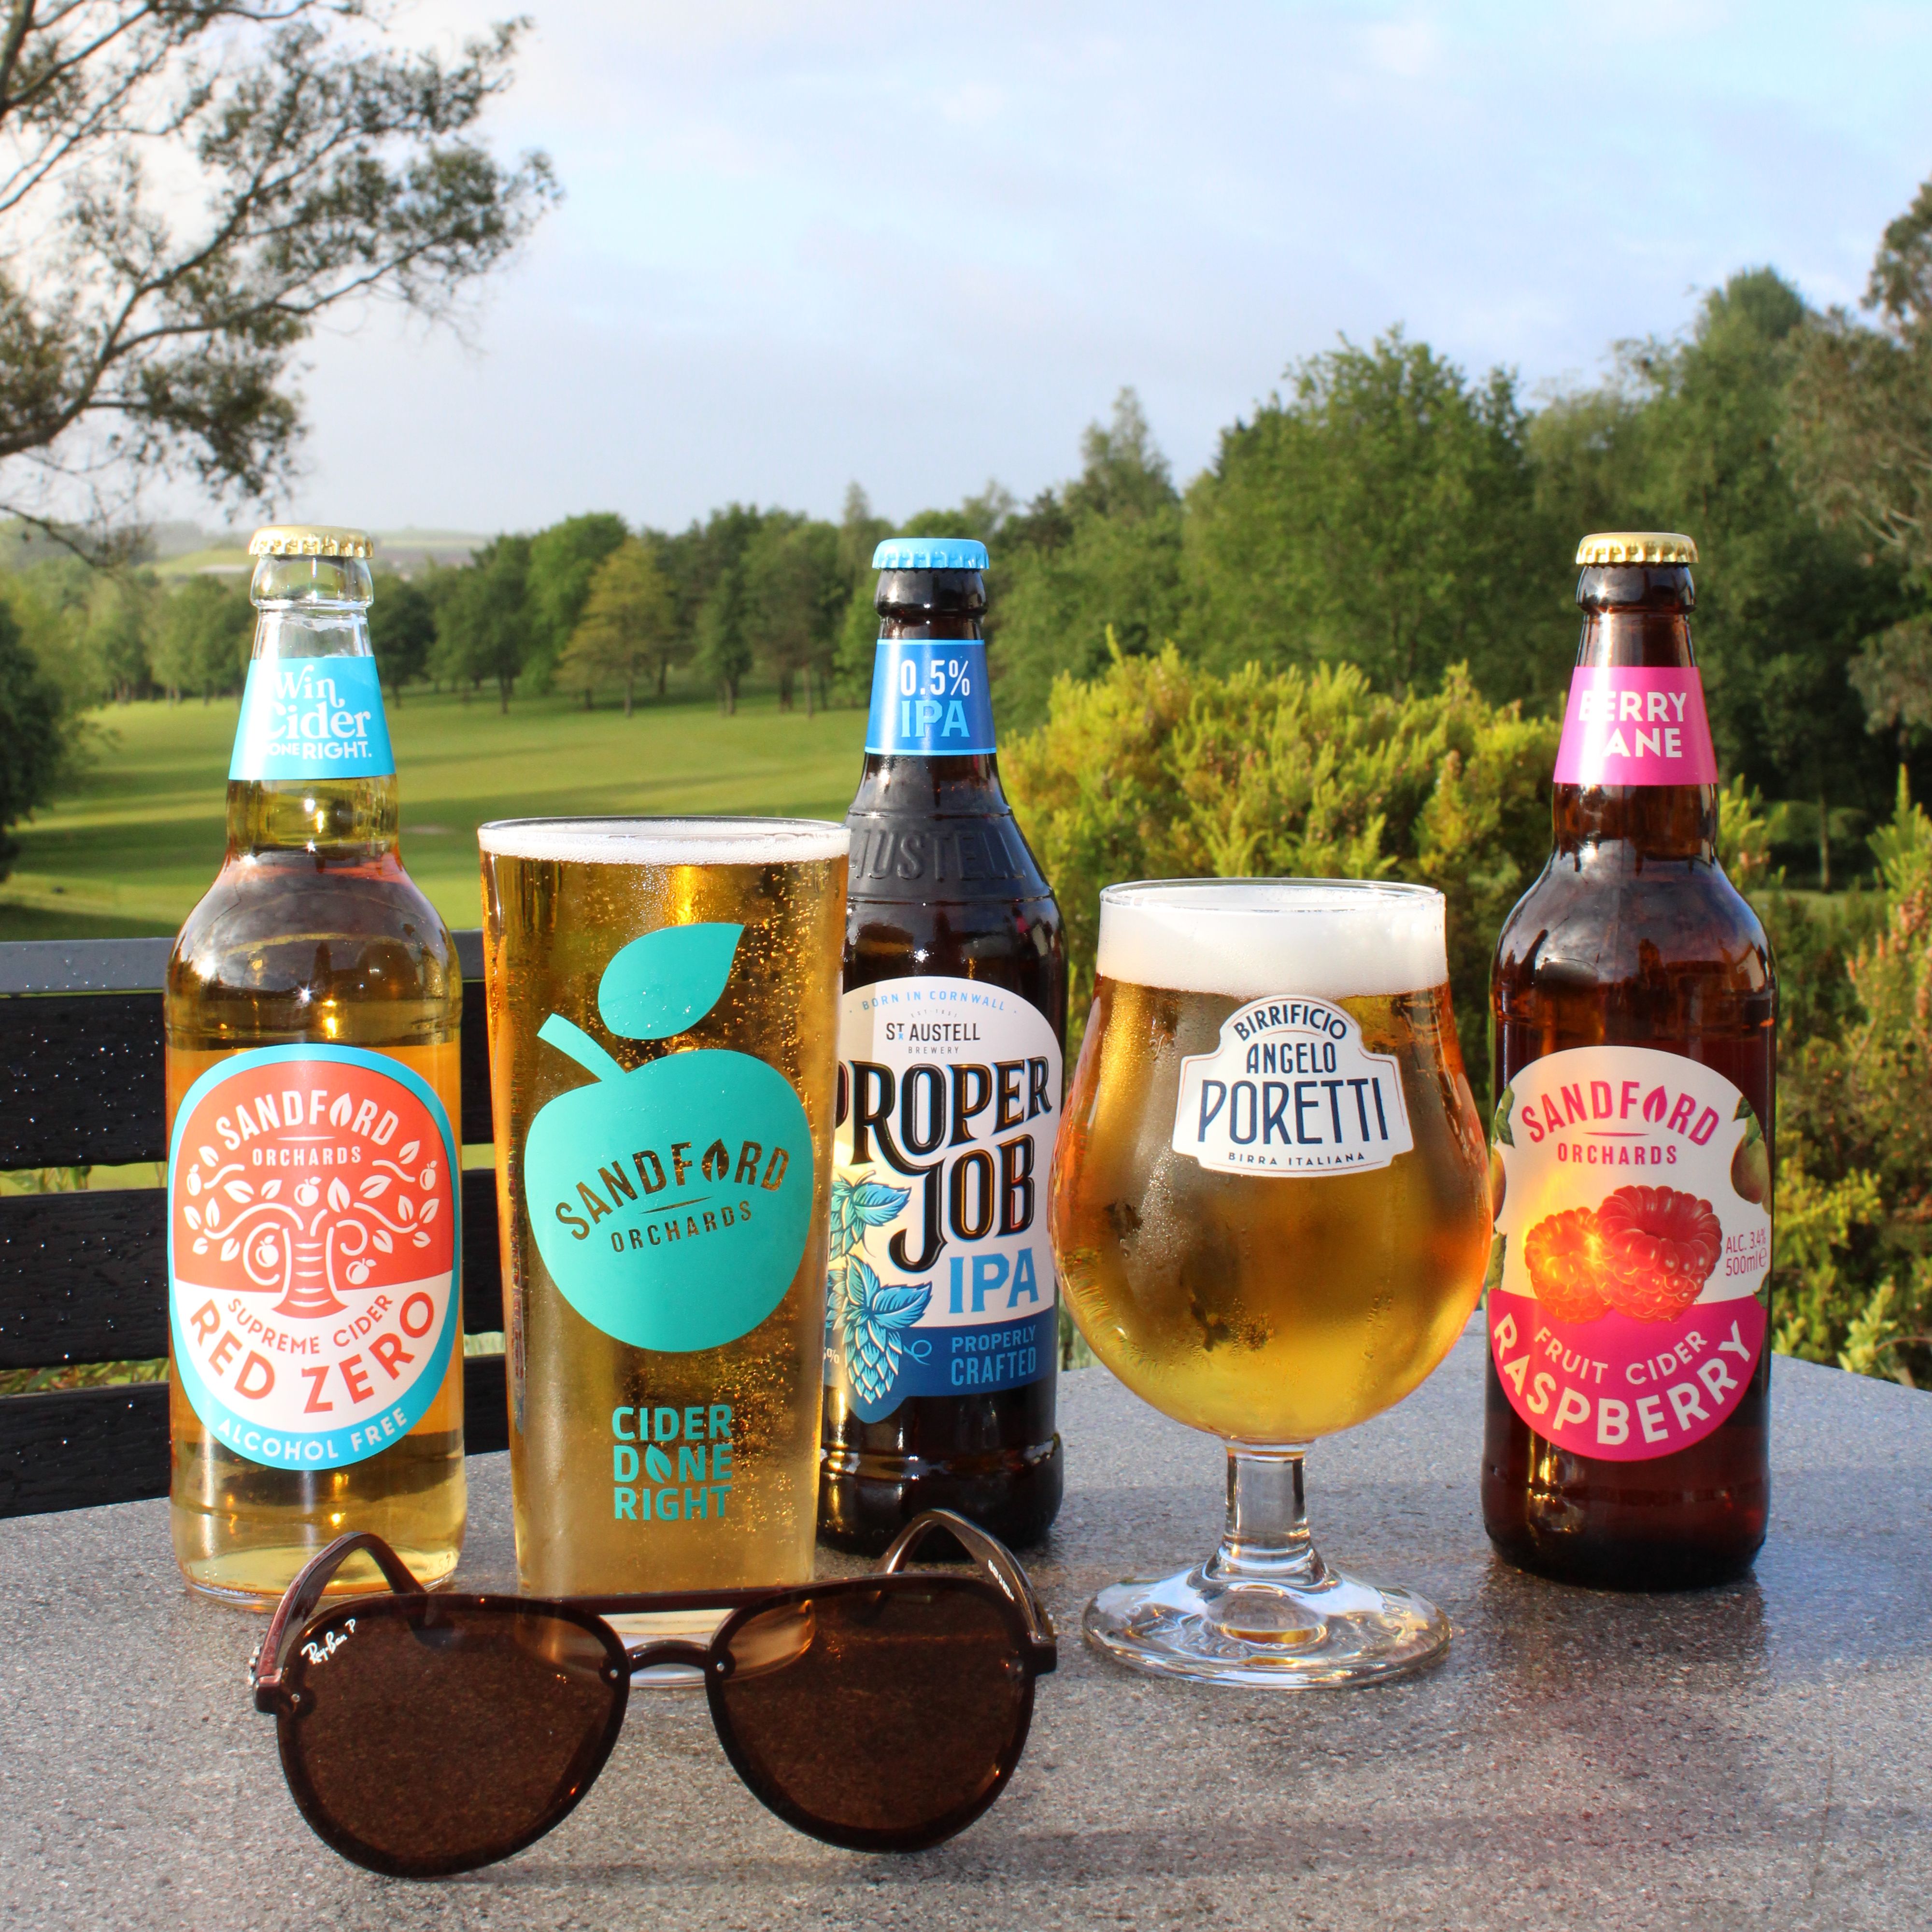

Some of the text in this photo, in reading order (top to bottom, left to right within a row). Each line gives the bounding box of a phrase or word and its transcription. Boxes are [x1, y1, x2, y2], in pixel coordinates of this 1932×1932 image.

[271, 665, 345, 708] Win
[900, 660, 970, 696] 0.5%
[265, 701, 371, 739] Cider
[901, 700, 970, 738] IPA
[261, 741, 372, 760] ONE RIGHT.
[1598, 728, 1682, 758] ANE
[862, 991, 1005, 1011] BORN IN CORNWALL
[909, 1023, 980, 1041] AUSTELL
[1234, 1004, 1347, 1041] BIRRIFICIO
[1246, 1042, 1336, 1074] ANGELO
[1197, 1077, 1388, 1145] PORETTI
[252, 1146, 361, 1166] ORCHARDS
[1228, 1152, 1364, 1166] BIRRA ITALIANA
[1558, 1143, 1677, 1165] ORCHARDS
[888, 1134, 1035, 1273] JOB
[611, 1200, 752, 1252] ORCHARDS
[1726, 1234, 1747, 1254] ALC.
[949, 1247, 1038, 1314] IPA
[228, 1294, 393, 1354] SUPREME CIDER
[952, 1325, 1036, 1353] PROPERLY
[190, 1292, 434, 1414] RED ZERO
[951, 1347, 1036, 1386] CRAFTED
[1534, 1326, 1707, 1385] FRUIT CIDER
[1494, 1313, 1750, 1445] RASPBERRY
[218, 1407, 407, 1461] ALCOHOL FREE
[612, 1404, 733, 1442] CIDER
[614, 1485, 733, 1521] RIGHT
